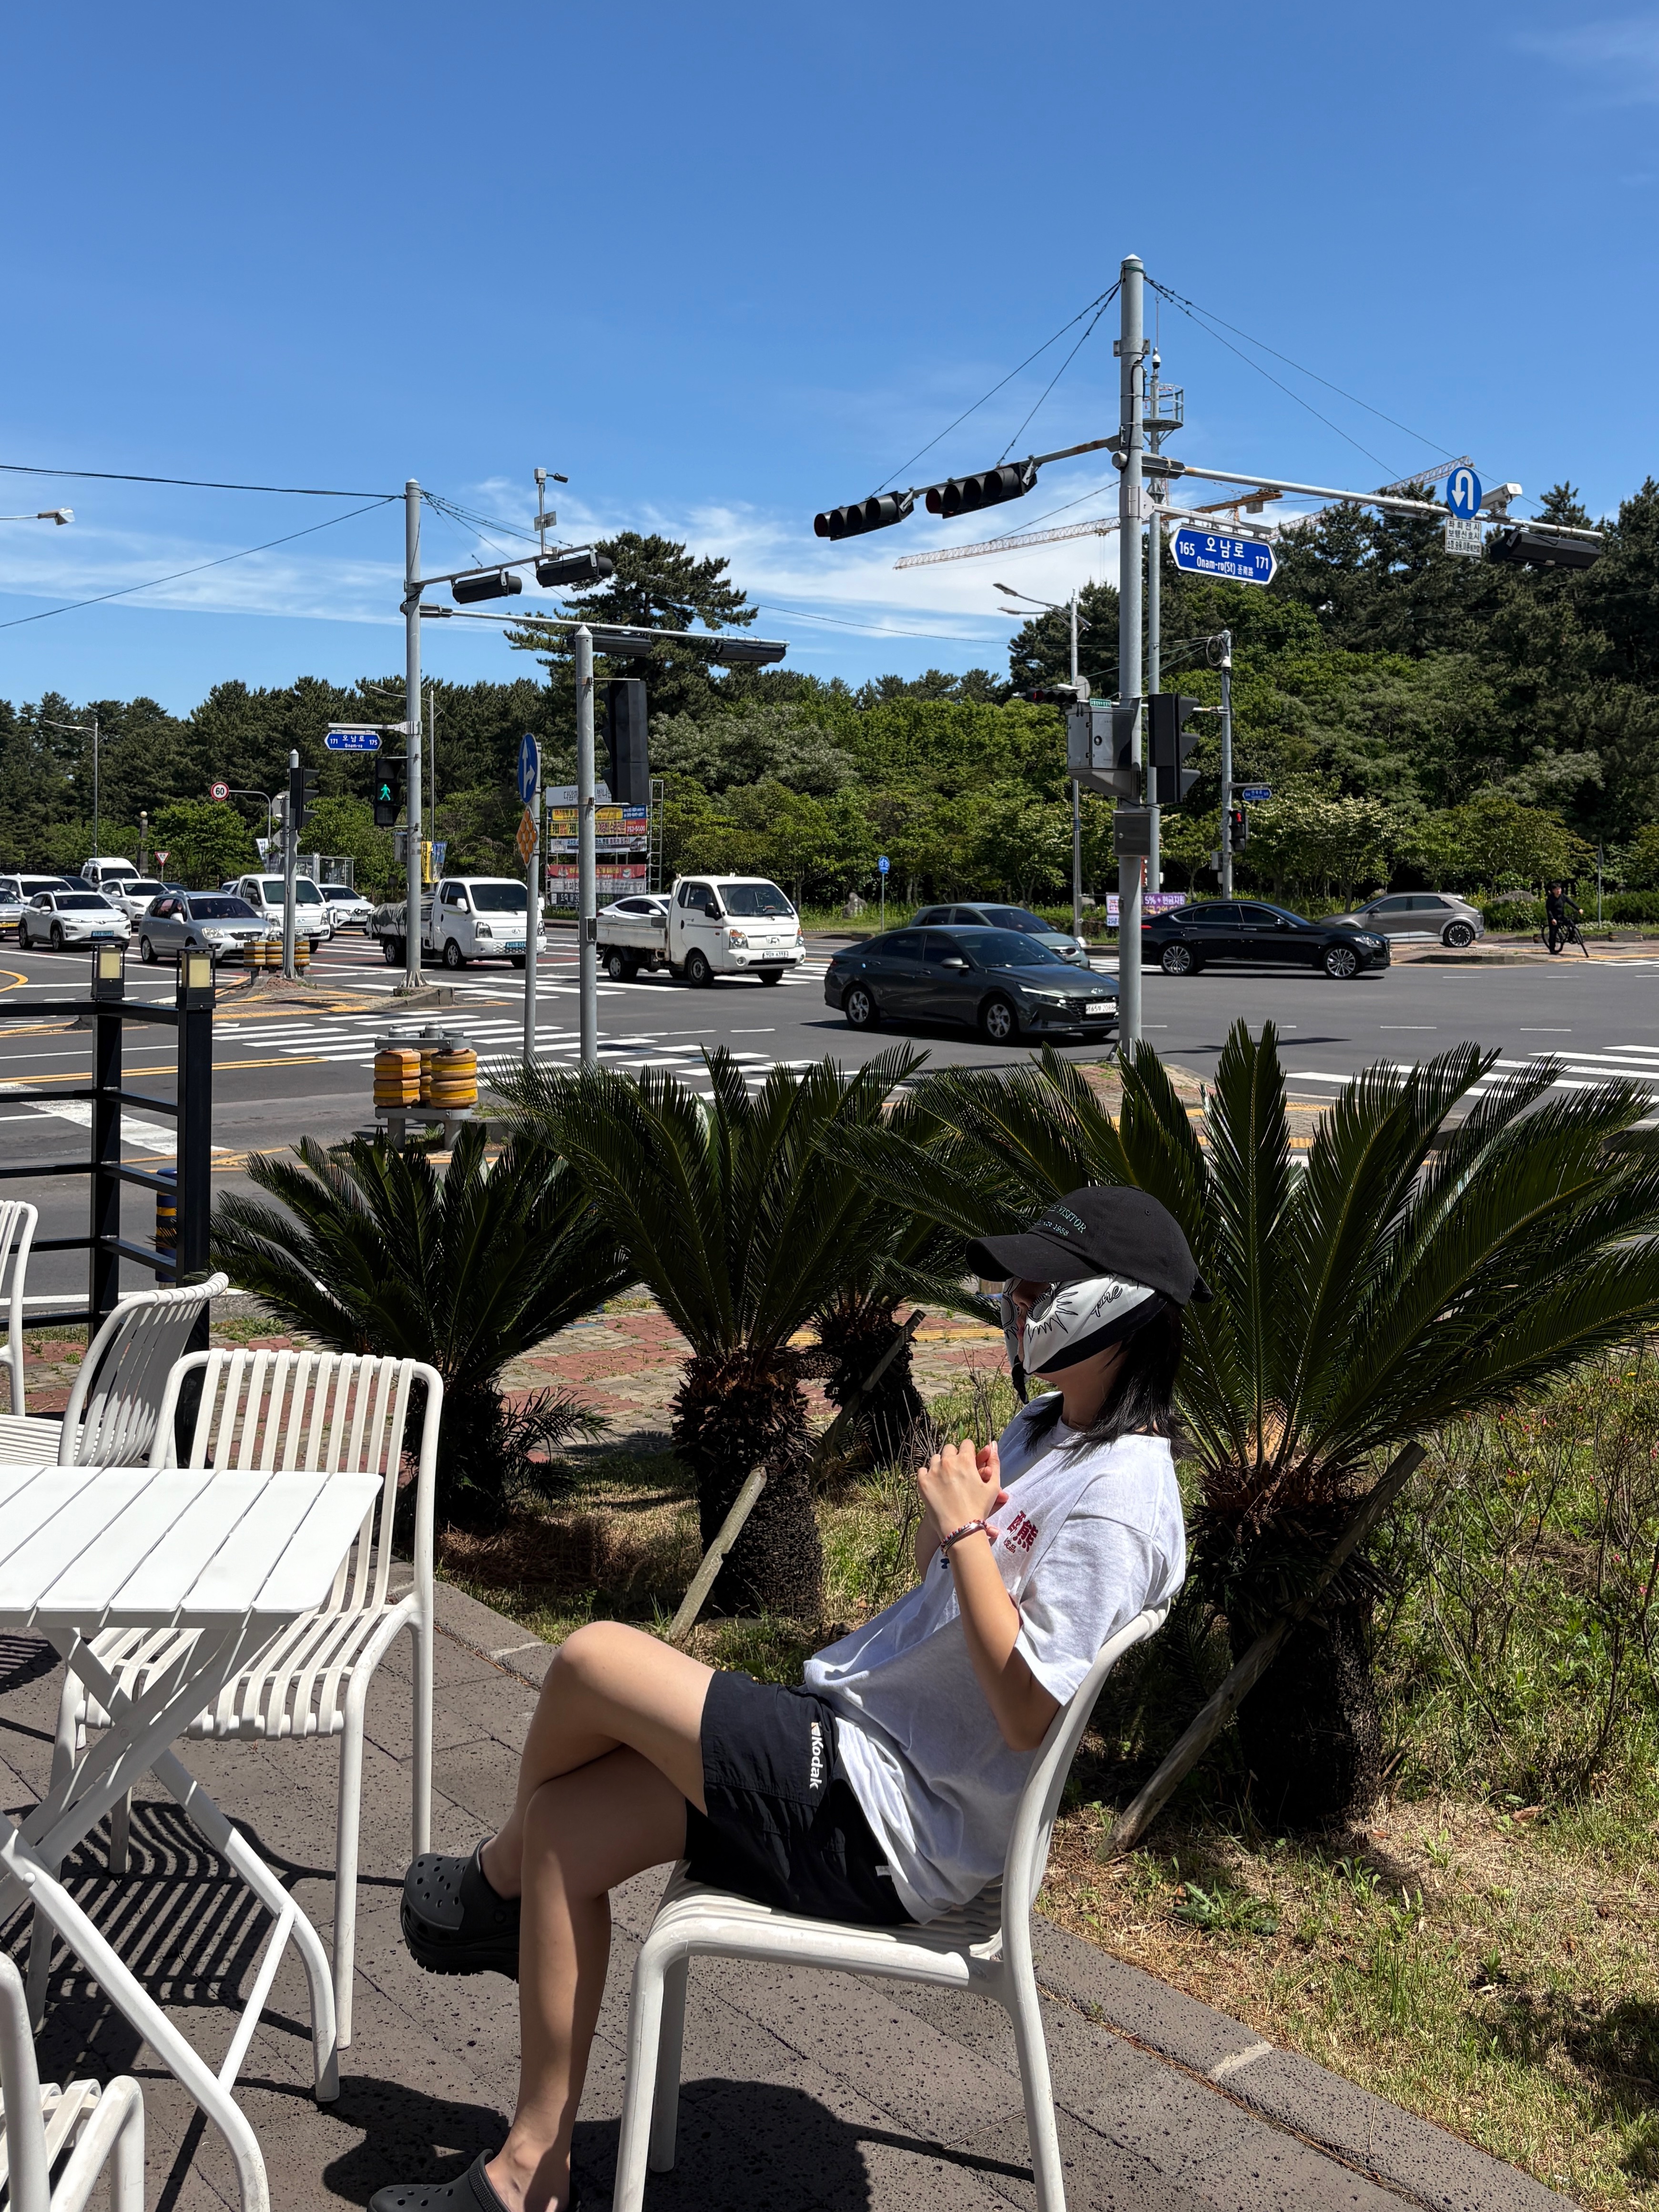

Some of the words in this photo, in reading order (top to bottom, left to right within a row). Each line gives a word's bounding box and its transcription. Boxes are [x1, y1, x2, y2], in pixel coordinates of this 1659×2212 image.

[1179, 541, 1195, 556] 165
[1205, 537, 1244, 558] 오남로
[1255, 556, 1269, 570] 171
[342, 735, 365, 743] 오남로
[215, 787, 224, 795] 60
[809, 1735, 824, 1790] Kodak
